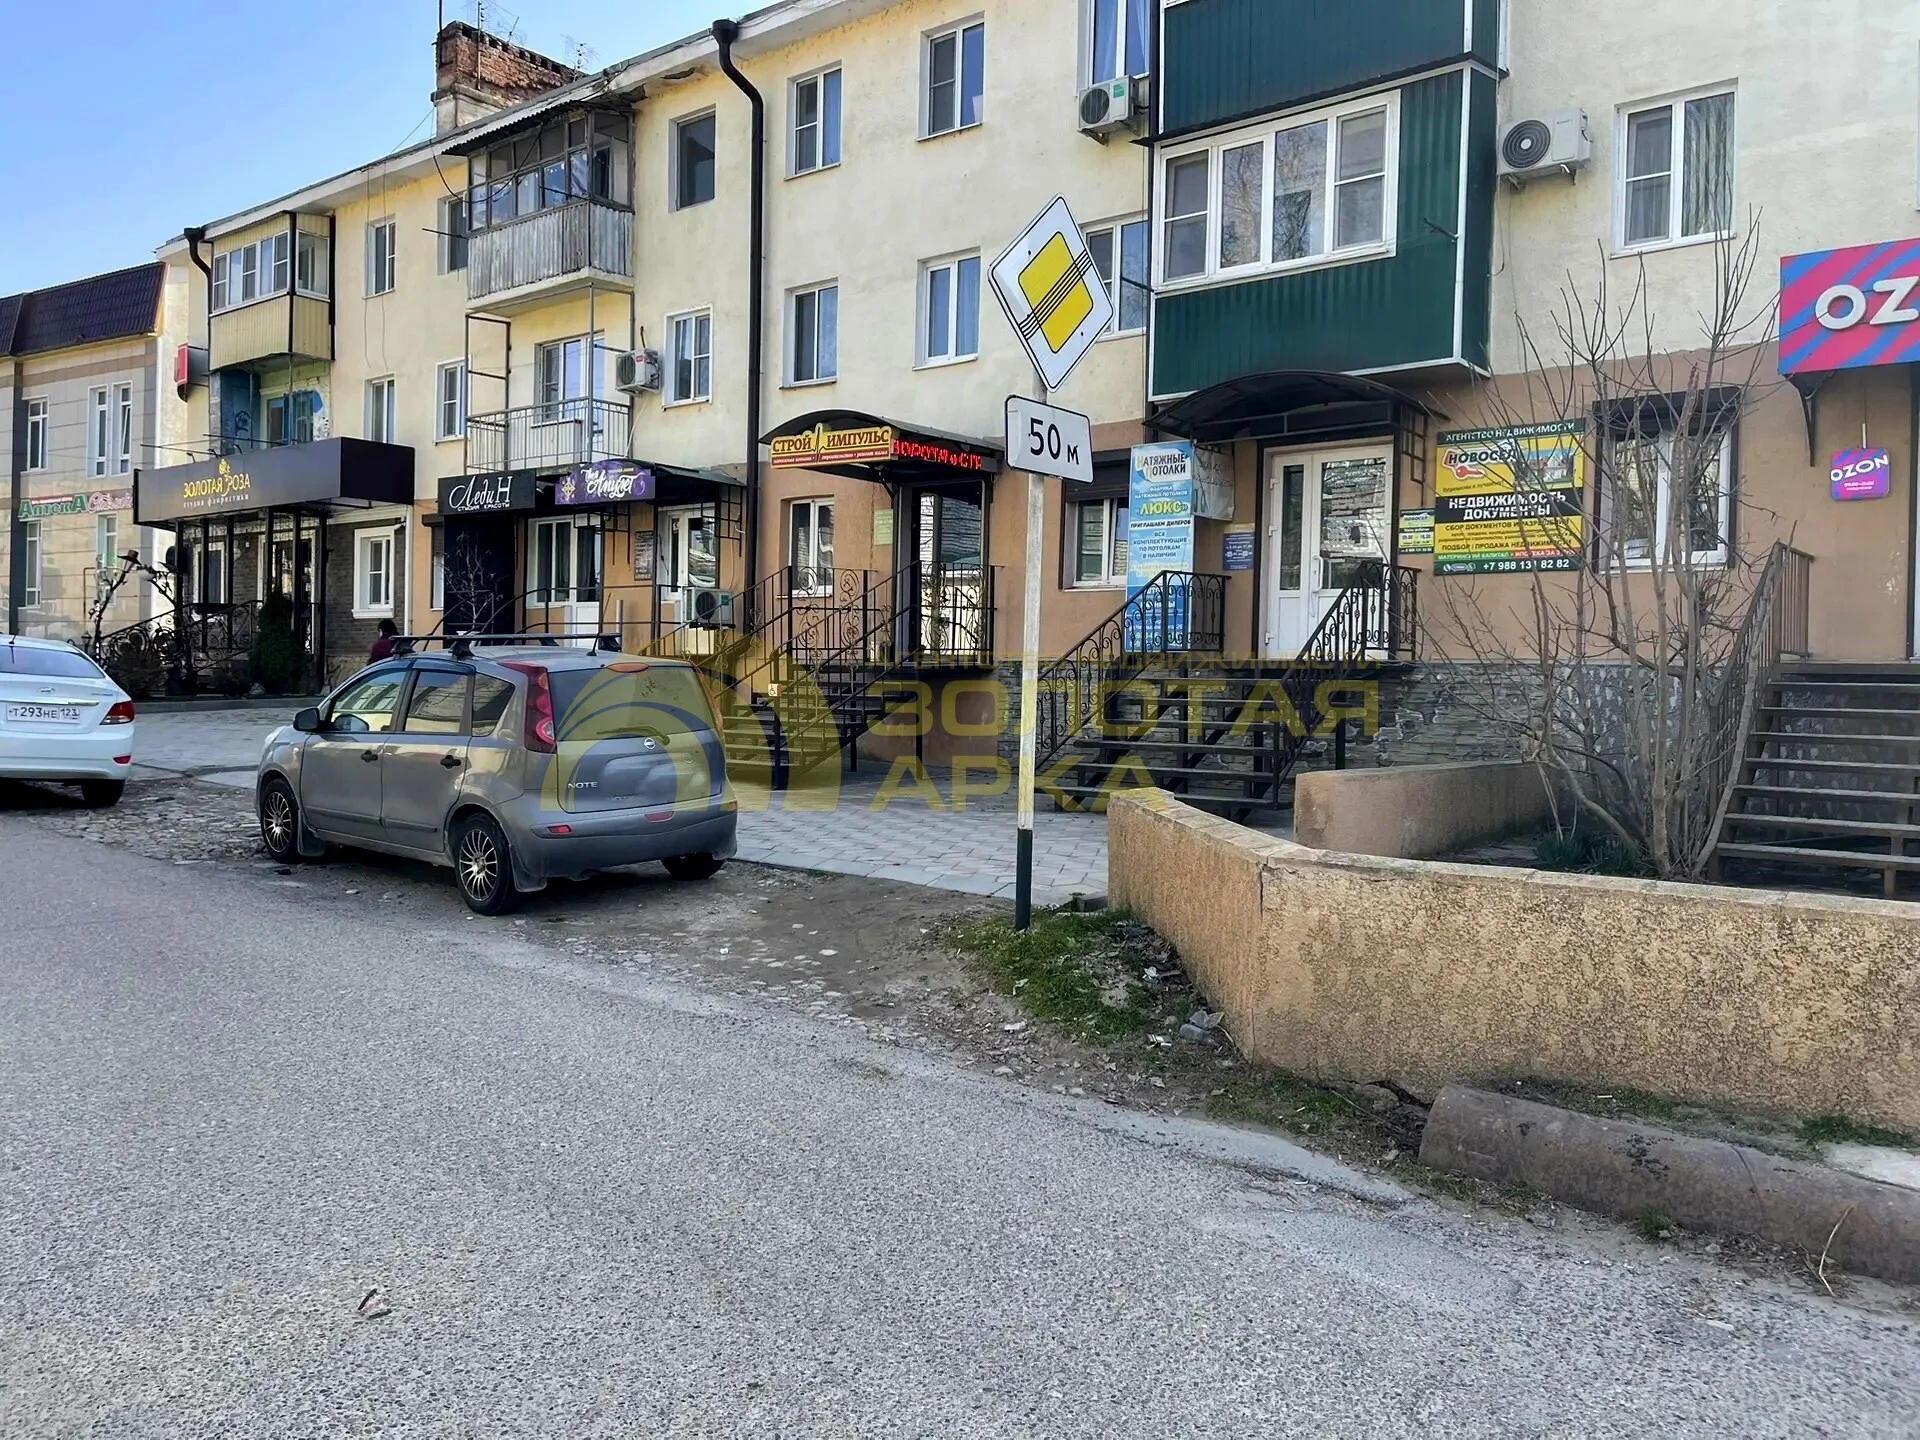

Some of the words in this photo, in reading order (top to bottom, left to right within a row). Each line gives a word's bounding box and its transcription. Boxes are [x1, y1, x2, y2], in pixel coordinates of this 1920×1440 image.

[772, 434, 812, 452] СТРОЙ
[826, 429, 890, 448] ИМПУЛЬС
[1030, 417, 1061, 460] 50
[1136, 453, 1186, 469] НАТЯЖНЫЕ
[1830, 454, 1889, 481] OZON
[183, 477, 223, 498] ЗОЛОТАЯ
[227, 472, 251, 491] РОЗА
[1463, 504, 1551, 520] ДОКУМЕНТЫ
[1130, 521, 1166, 529] ПРИГЛАШАЕМ
[1465, 521, 1512, 530] ДОКУМЕНТОВ
[1441, 543, 1471, 551] ПОДБОР
[1475, 542, 1511, 550] ПРОДАЖА
[1483, 562, 1496, 570] +7
[1498, 561, 1517, 570] 988
[1541, 559, 1554, 569] 82
[1556, 558, 1570, 568] 82
[568, 781, 598, 789] NOTE
